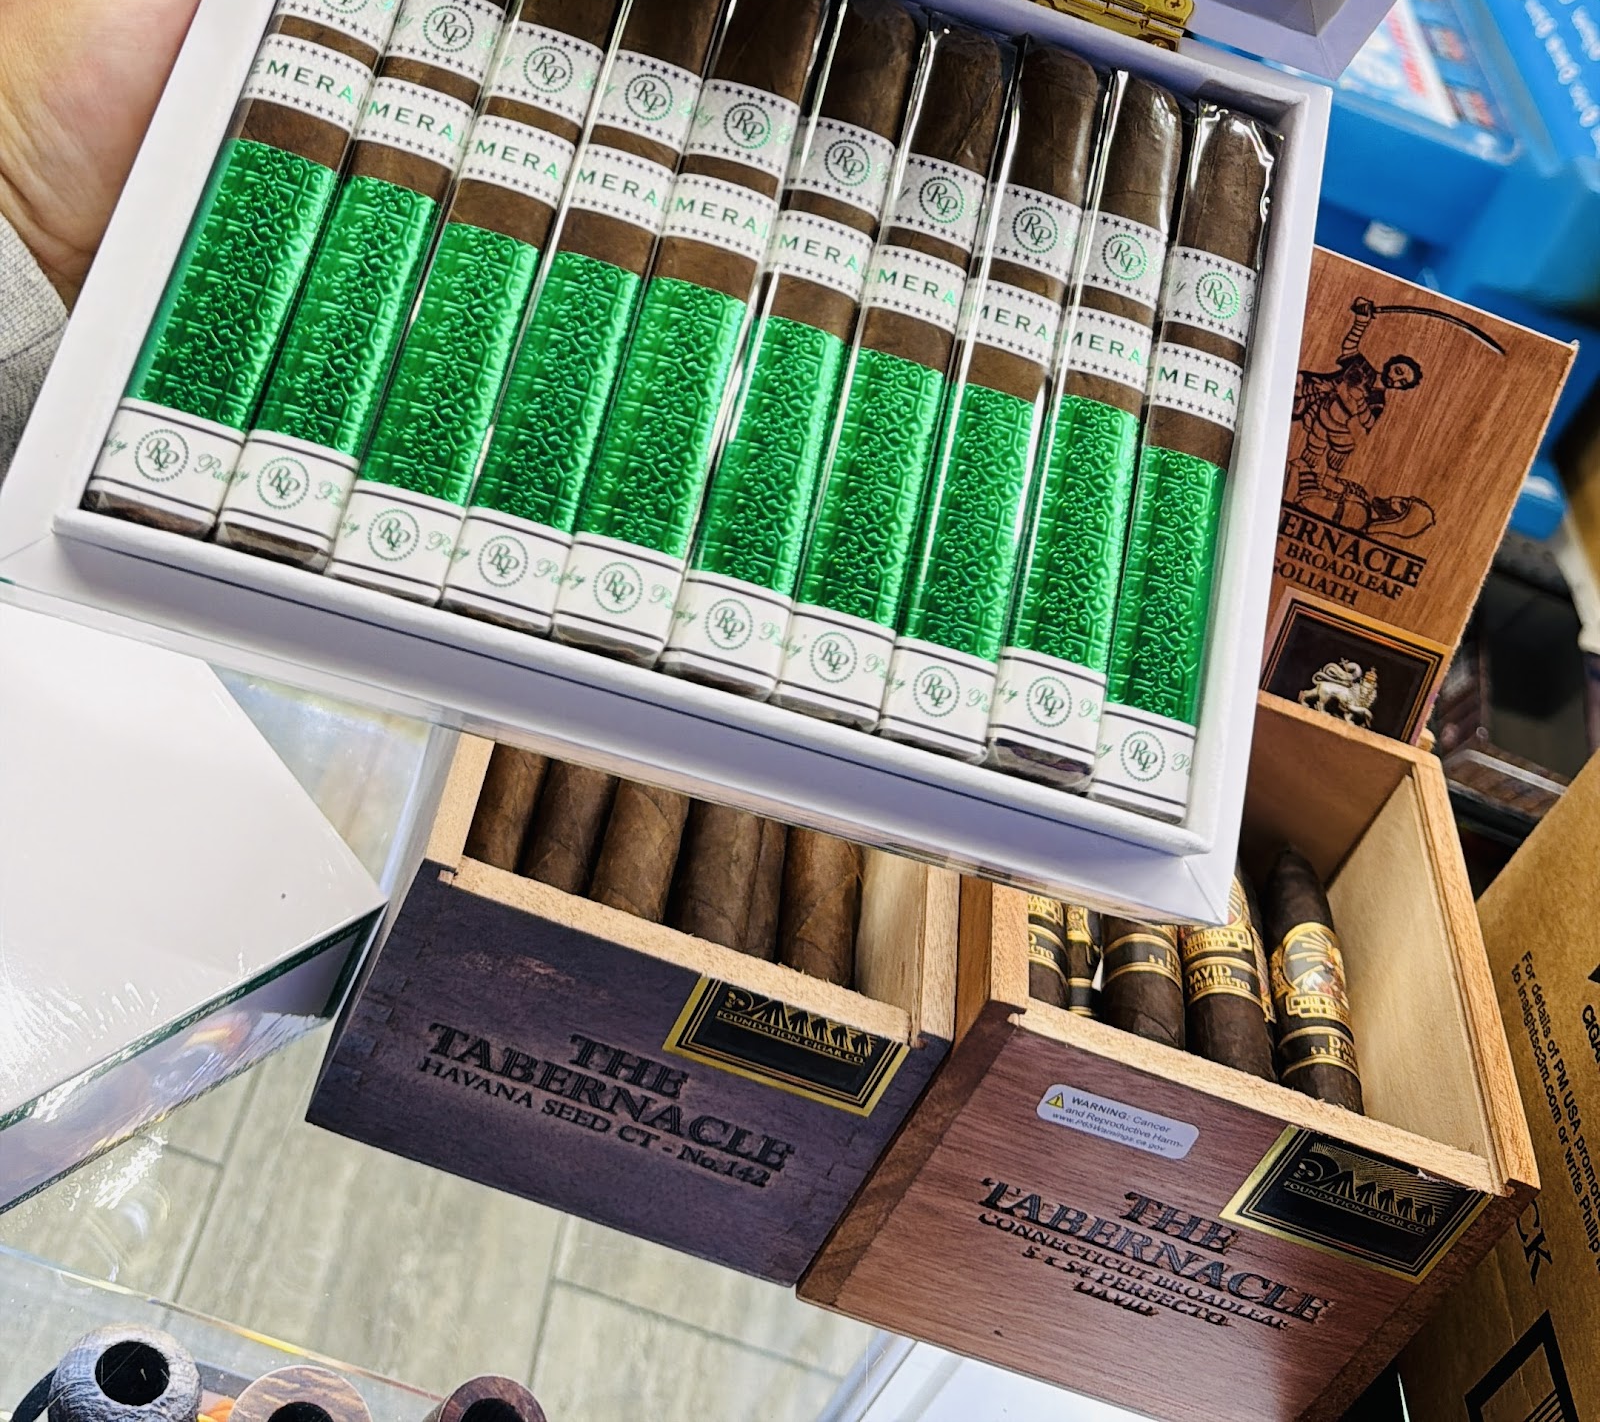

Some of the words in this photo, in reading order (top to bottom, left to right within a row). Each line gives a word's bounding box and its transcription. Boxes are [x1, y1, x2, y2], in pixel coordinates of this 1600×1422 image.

[476, 140, 559, 180] MERA
[576, 168, 660, 207] MERA
[780, 234, 860, 274] MERA
[878, 268, 957, 307] MERA
[973, 304, 1050, 342] MERA
[1062, 332, 1143, 366] MERA
[1158, 366, 1236, 406] MERA
[1278, 511, 1424, 587] ERNACLE
[1285, 543, 1403, 600] BROADLEAF
[716, 1009, 801, 1043] FOUNDATION
[804, 1039, 842, 1057] CIGAR
[1522, 951, 1536, 980] For
[1531, 983, 1552, 1038] details
[1547, 1039, 1559, 1059] of
[1553, 1058, 1569, 1092] PM
[1563, 1090, 1581, 1135] USA
[569, 1033, 690, 1099] THE
[419, 1056, 533, 1109] HAVANA
[541, 1098, 611, 1133] SEED
[617, 1124, 661, 1148] CT
[428, 1022, 795, 1172] TABERNACLE
[1071, 1095, 1131, 1121] WARNING:
[1132, 1115, 1171, 1134] Cancer
[1511, 964, 1521, 985] to
[1558, 1126, 1569, 1146] or
[1565, 1147, 1583, 1196] write
[1579, 1194, 1600, 1254] Philip
[1065, 1107, 1085, 1119] and
[1086, 1112, 1151, 1138] Reproductive
[1119, 1191, 1239, 1255] THE
[1283, 1180, 1365, 1214] FOUNDATION
[1368, 1209, 1404, 1226] CIGAR
[978, 1178, 1334, 1323] TABERNACLE
[978, 1212, 1153, 1280] CONNECTICUT
[1152, 1275, 1292, 1331] BROADLEAF
[1022, 1245, 1041, 1259] 5
[1095, 1271, 1230, 1326] PERFECTO
[1073, 1281, 1159, 1317] DAVID
